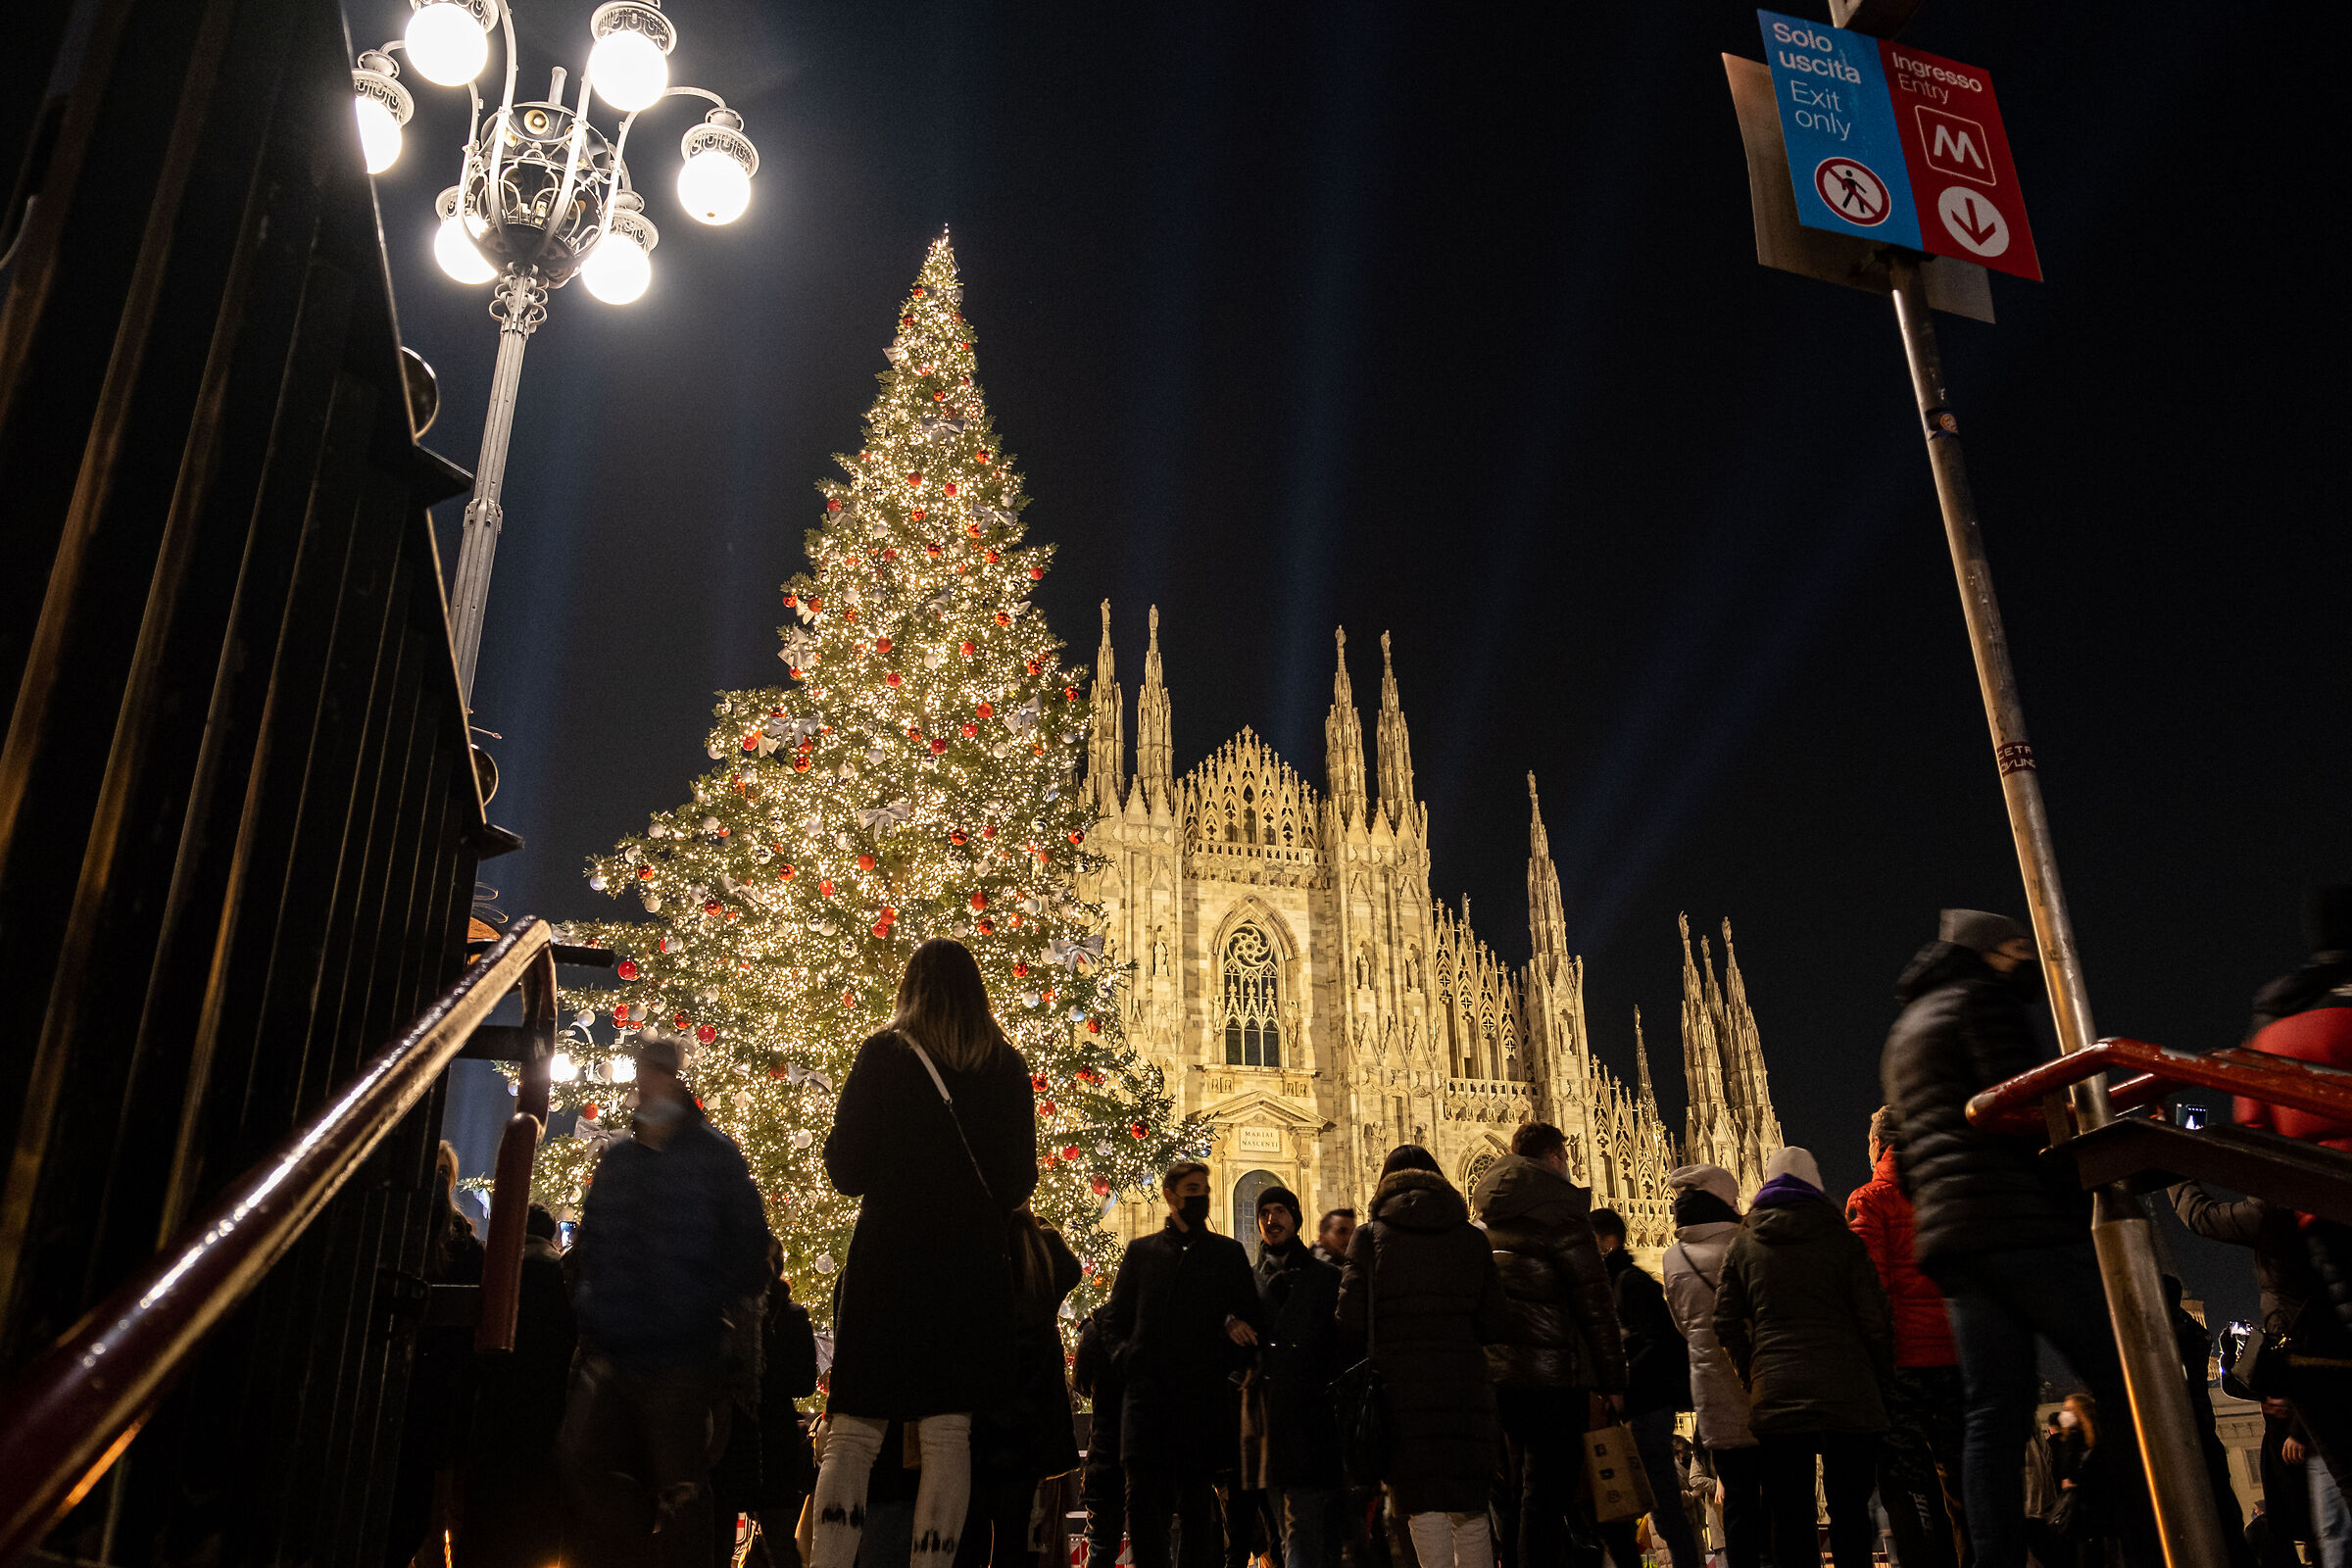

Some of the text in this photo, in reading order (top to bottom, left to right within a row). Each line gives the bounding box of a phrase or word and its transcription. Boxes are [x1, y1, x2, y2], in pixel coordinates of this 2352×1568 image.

[1772, 22, 1833, 53] Solo
[1779, 50, 1861, 84] uscita
[1891, 52, 1983, 93] Ingresso
[1790, 79, 1842, 113] Exit
[1898, 73, 1949, 105] Entry
[1794, 109, 1851, 141] only
[1934, 123, 1985, 170] M
